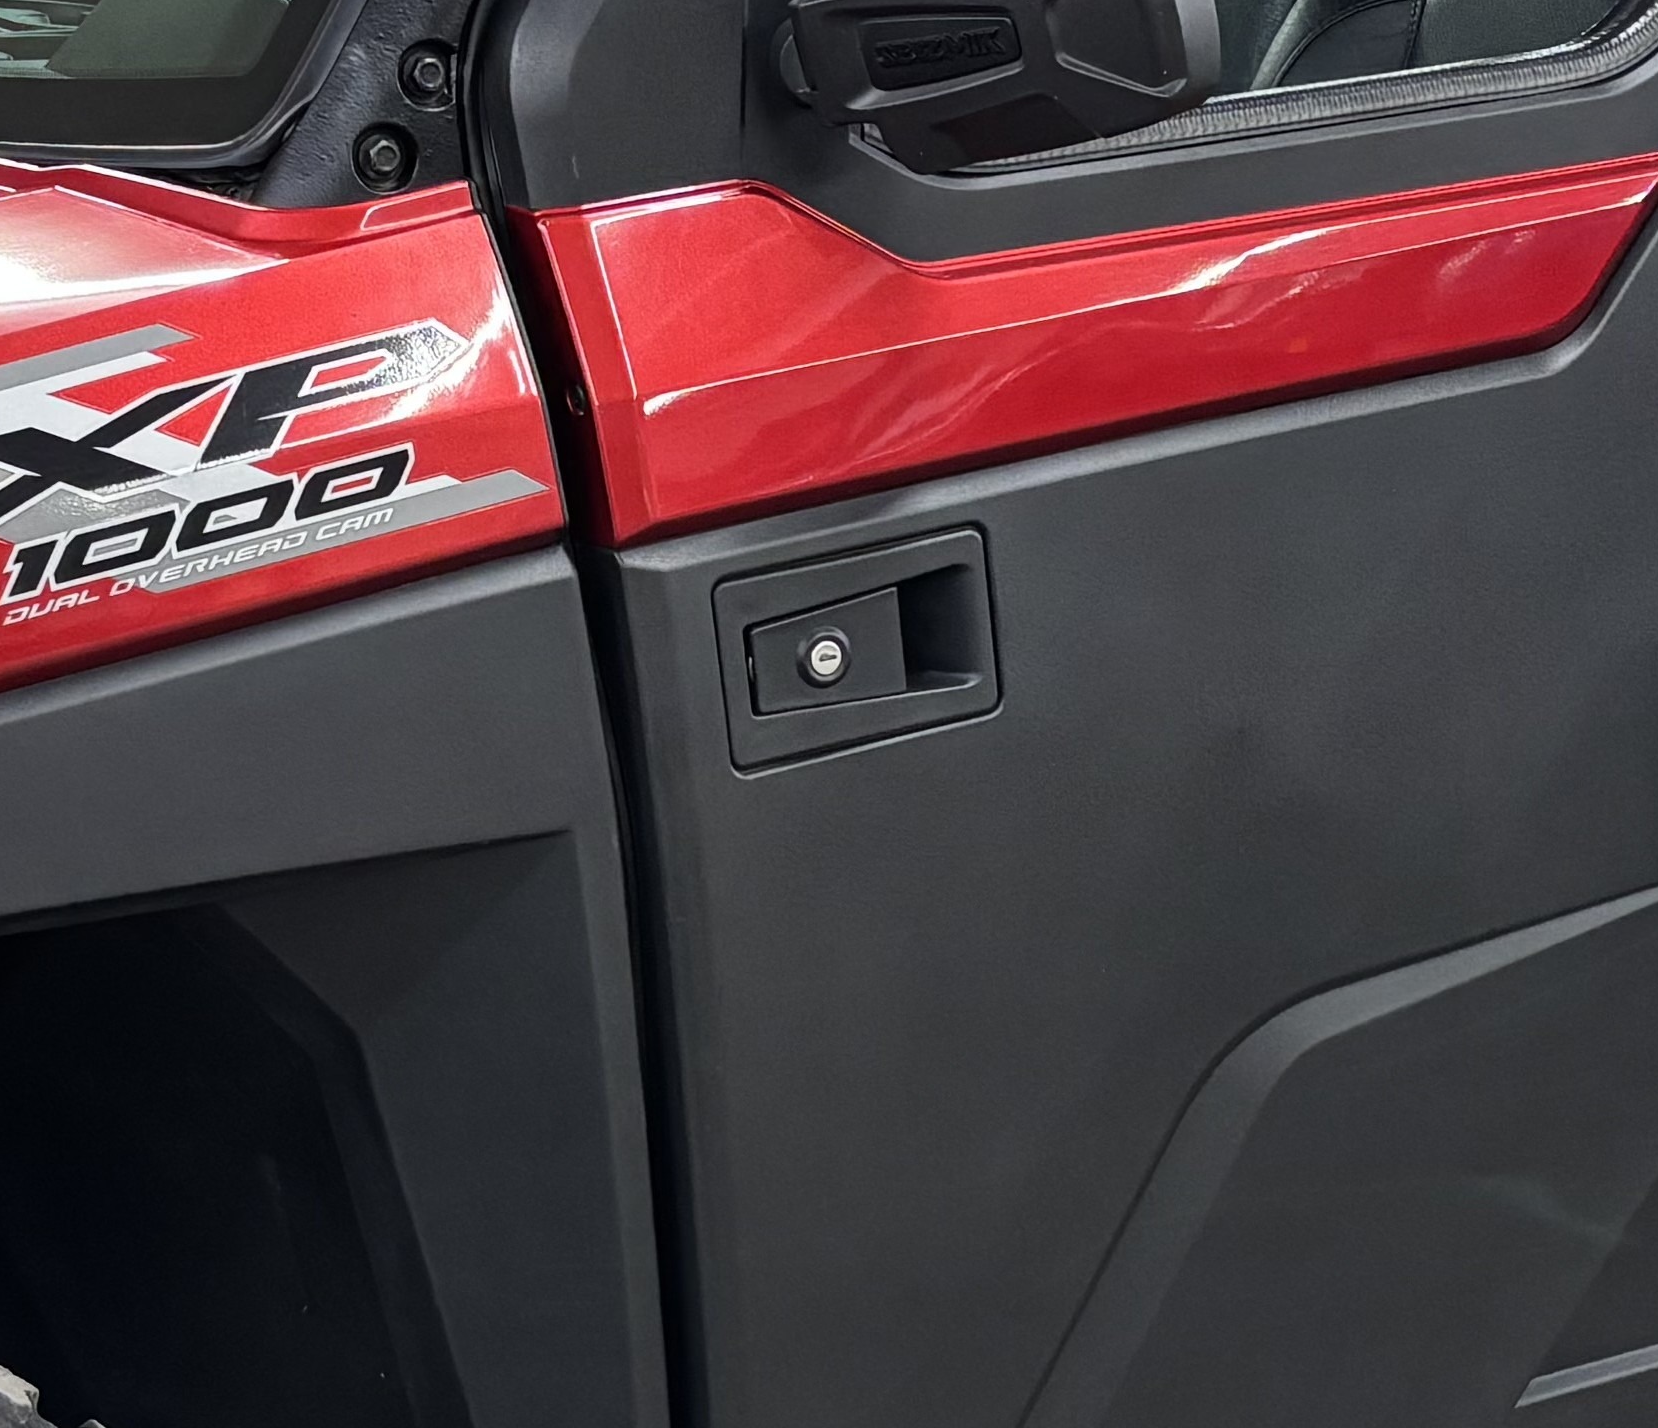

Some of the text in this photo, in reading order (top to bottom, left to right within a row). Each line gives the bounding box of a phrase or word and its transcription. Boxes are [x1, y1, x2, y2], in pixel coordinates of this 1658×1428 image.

[2, 506, 394, 627] DUAL OVERHEAD CAM
